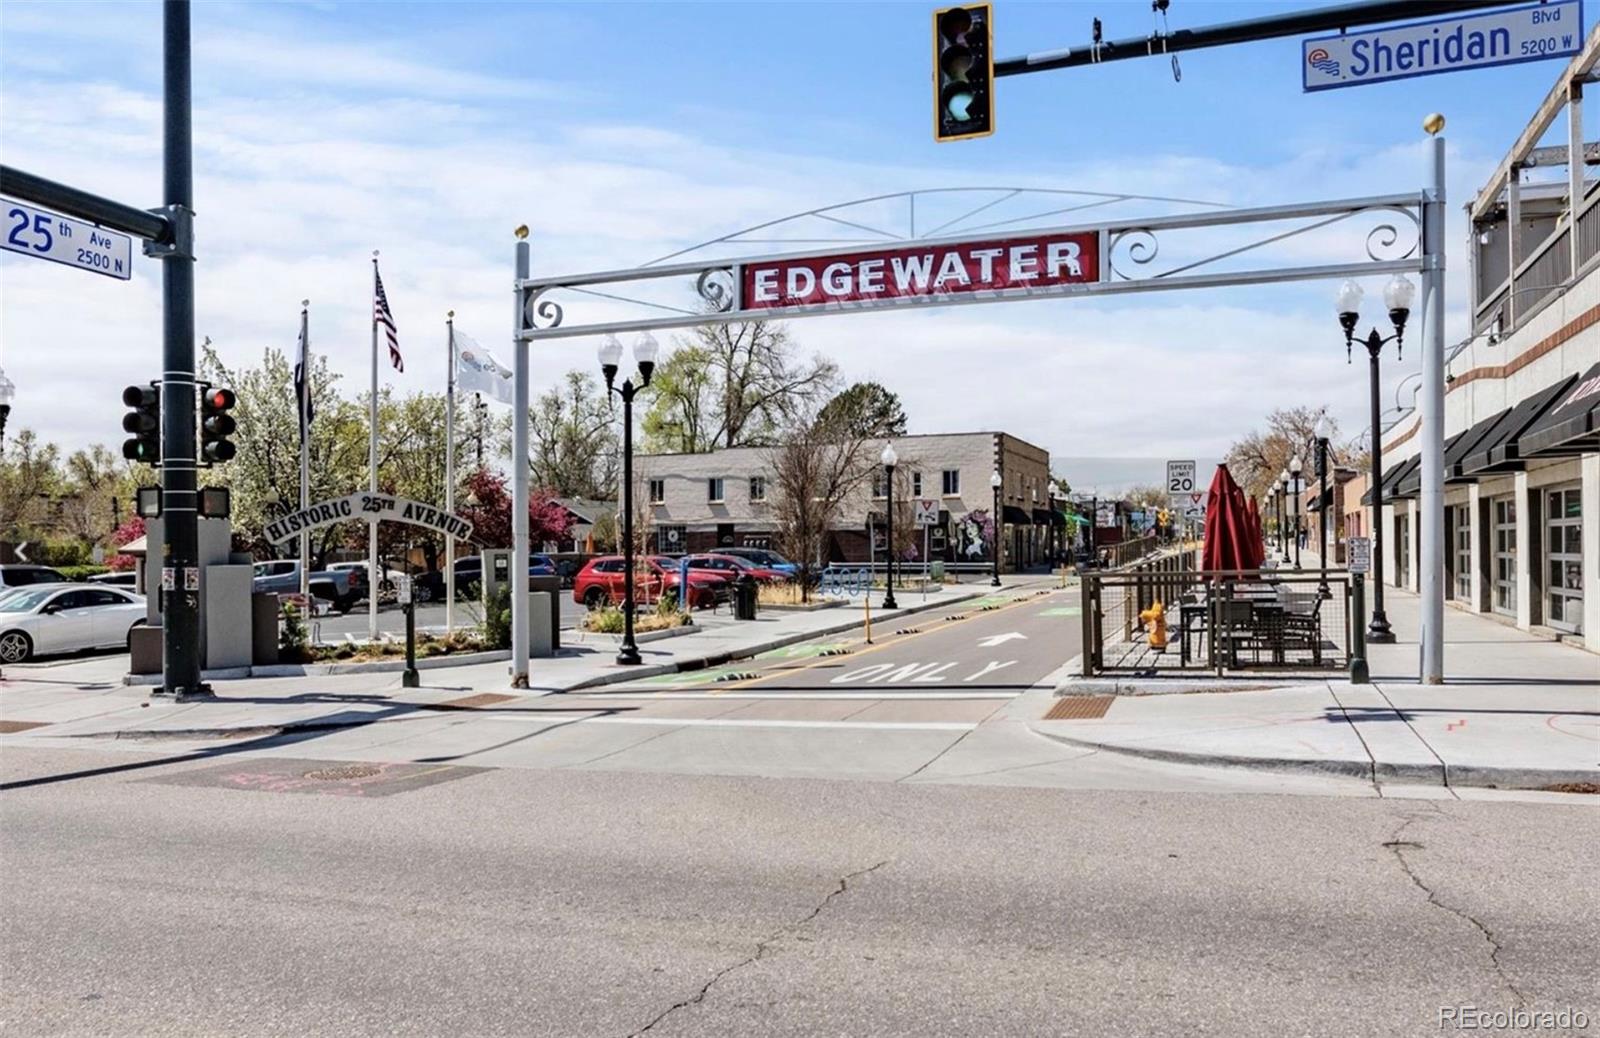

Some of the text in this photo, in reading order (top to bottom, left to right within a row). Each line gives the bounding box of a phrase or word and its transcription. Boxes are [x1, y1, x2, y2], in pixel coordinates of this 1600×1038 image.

[1350, 8, 1561, 77] Sheridan Blvd
[1521, 35, 1573, 55] 5200 W
[90, 231, 112, 250] Ave
[77, 248, 123, 273] 2500 N
[753, 241, 1082, 303] EDGEWATER
[1170, 478, 1193, 491] 20
[266, 496, 471, 542] HISTORIC 25TH AVENUE
[829, 660, 1019, 684] ONLY
